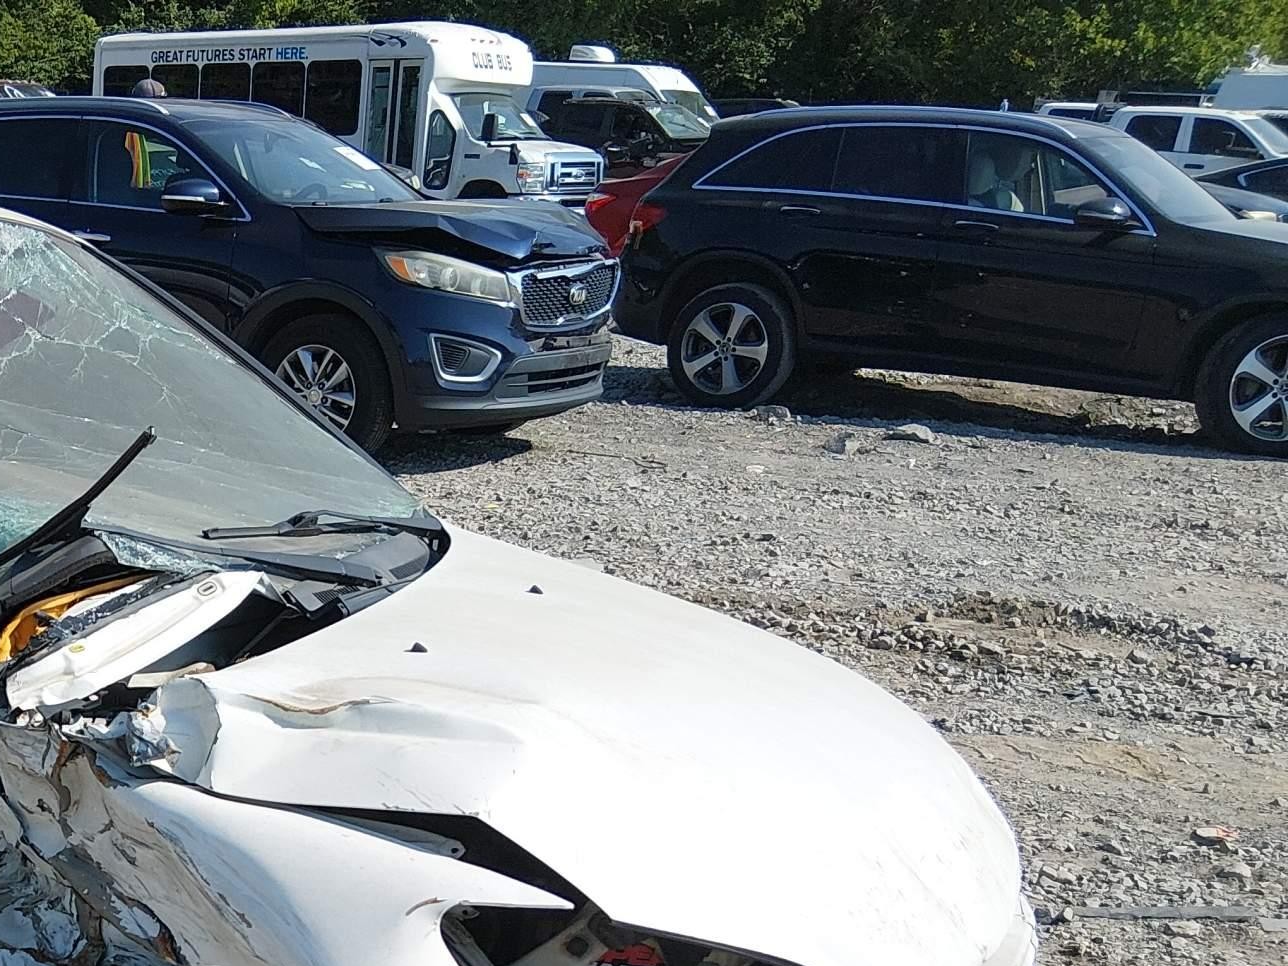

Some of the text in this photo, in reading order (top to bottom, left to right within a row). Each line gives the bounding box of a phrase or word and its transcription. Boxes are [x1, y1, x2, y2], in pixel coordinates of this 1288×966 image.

[151, 46, 309, 63] GREAT FUTURES START HERE.
[472, 52, 512, 71] CLUB BUS
